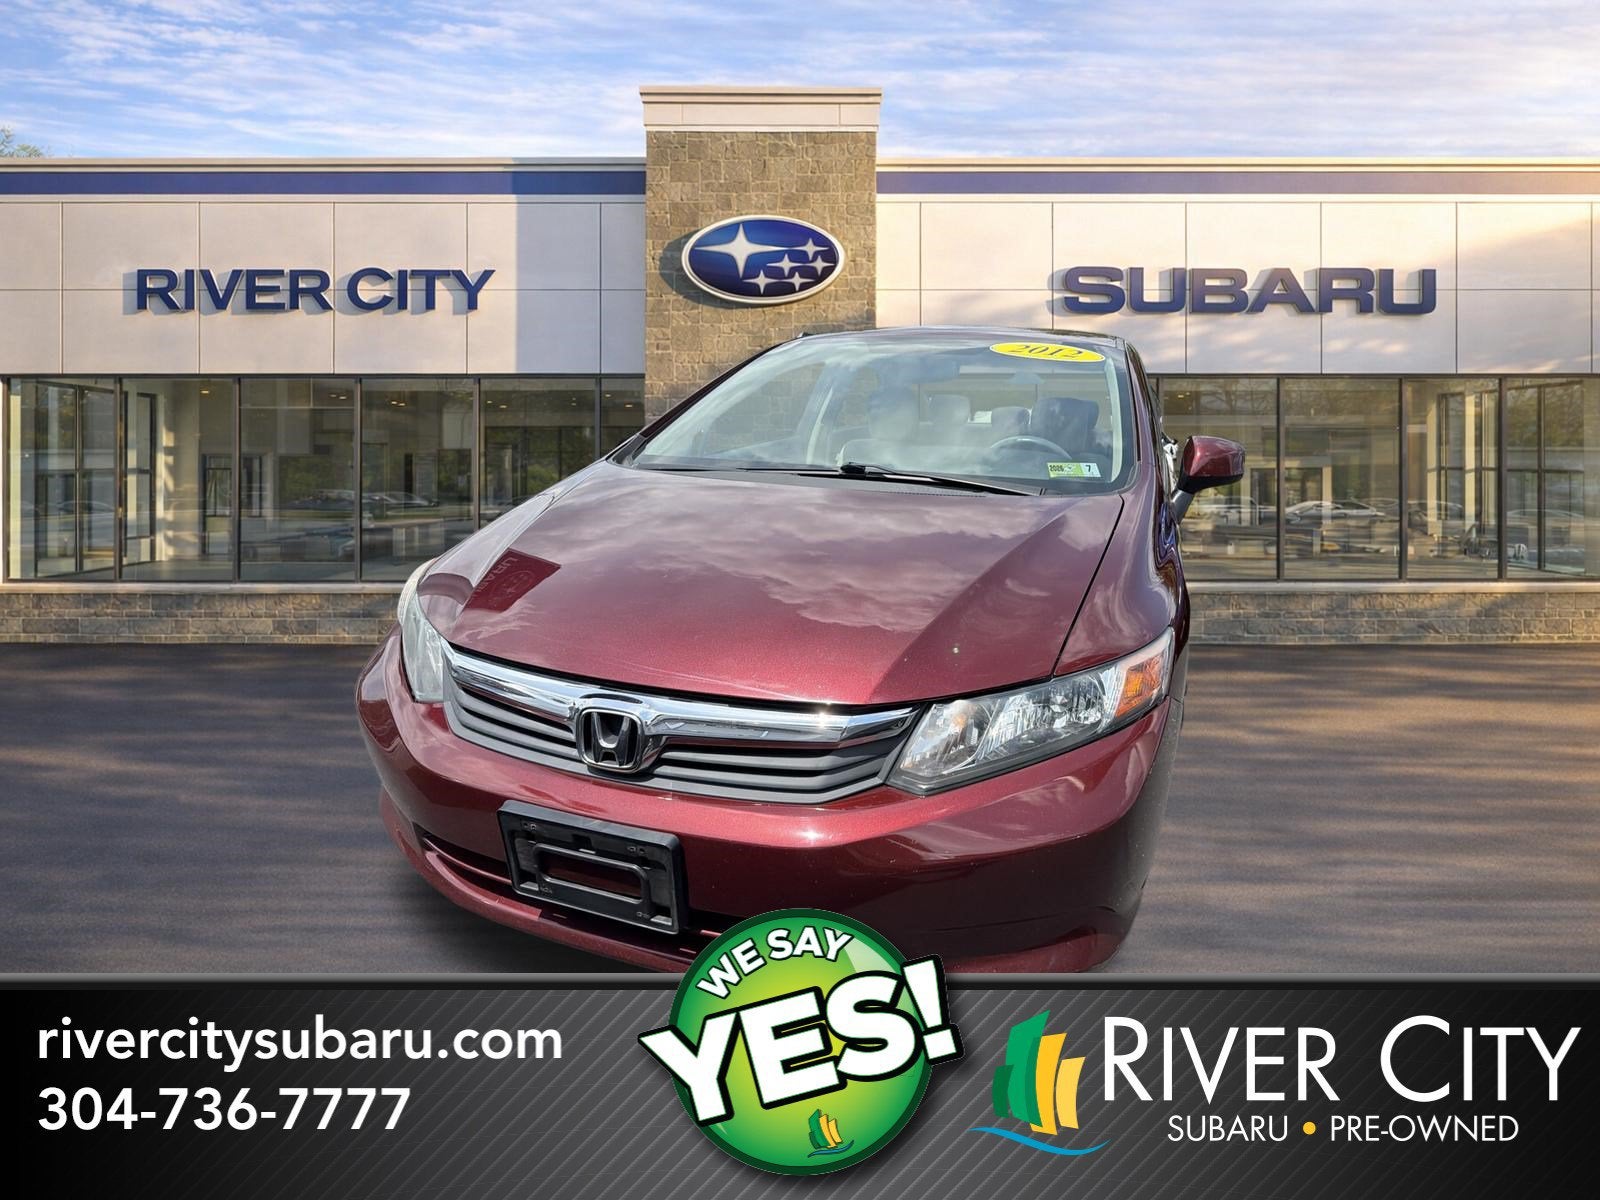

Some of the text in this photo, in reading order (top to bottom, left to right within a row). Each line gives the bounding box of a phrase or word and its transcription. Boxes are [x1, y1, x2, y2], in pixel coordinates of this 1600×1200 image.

[136, 267, 495, 311] RIVER CITY
[1063, 266, 1437, 314] SUBARU
[1008, 345, 1083, 358] 2012
